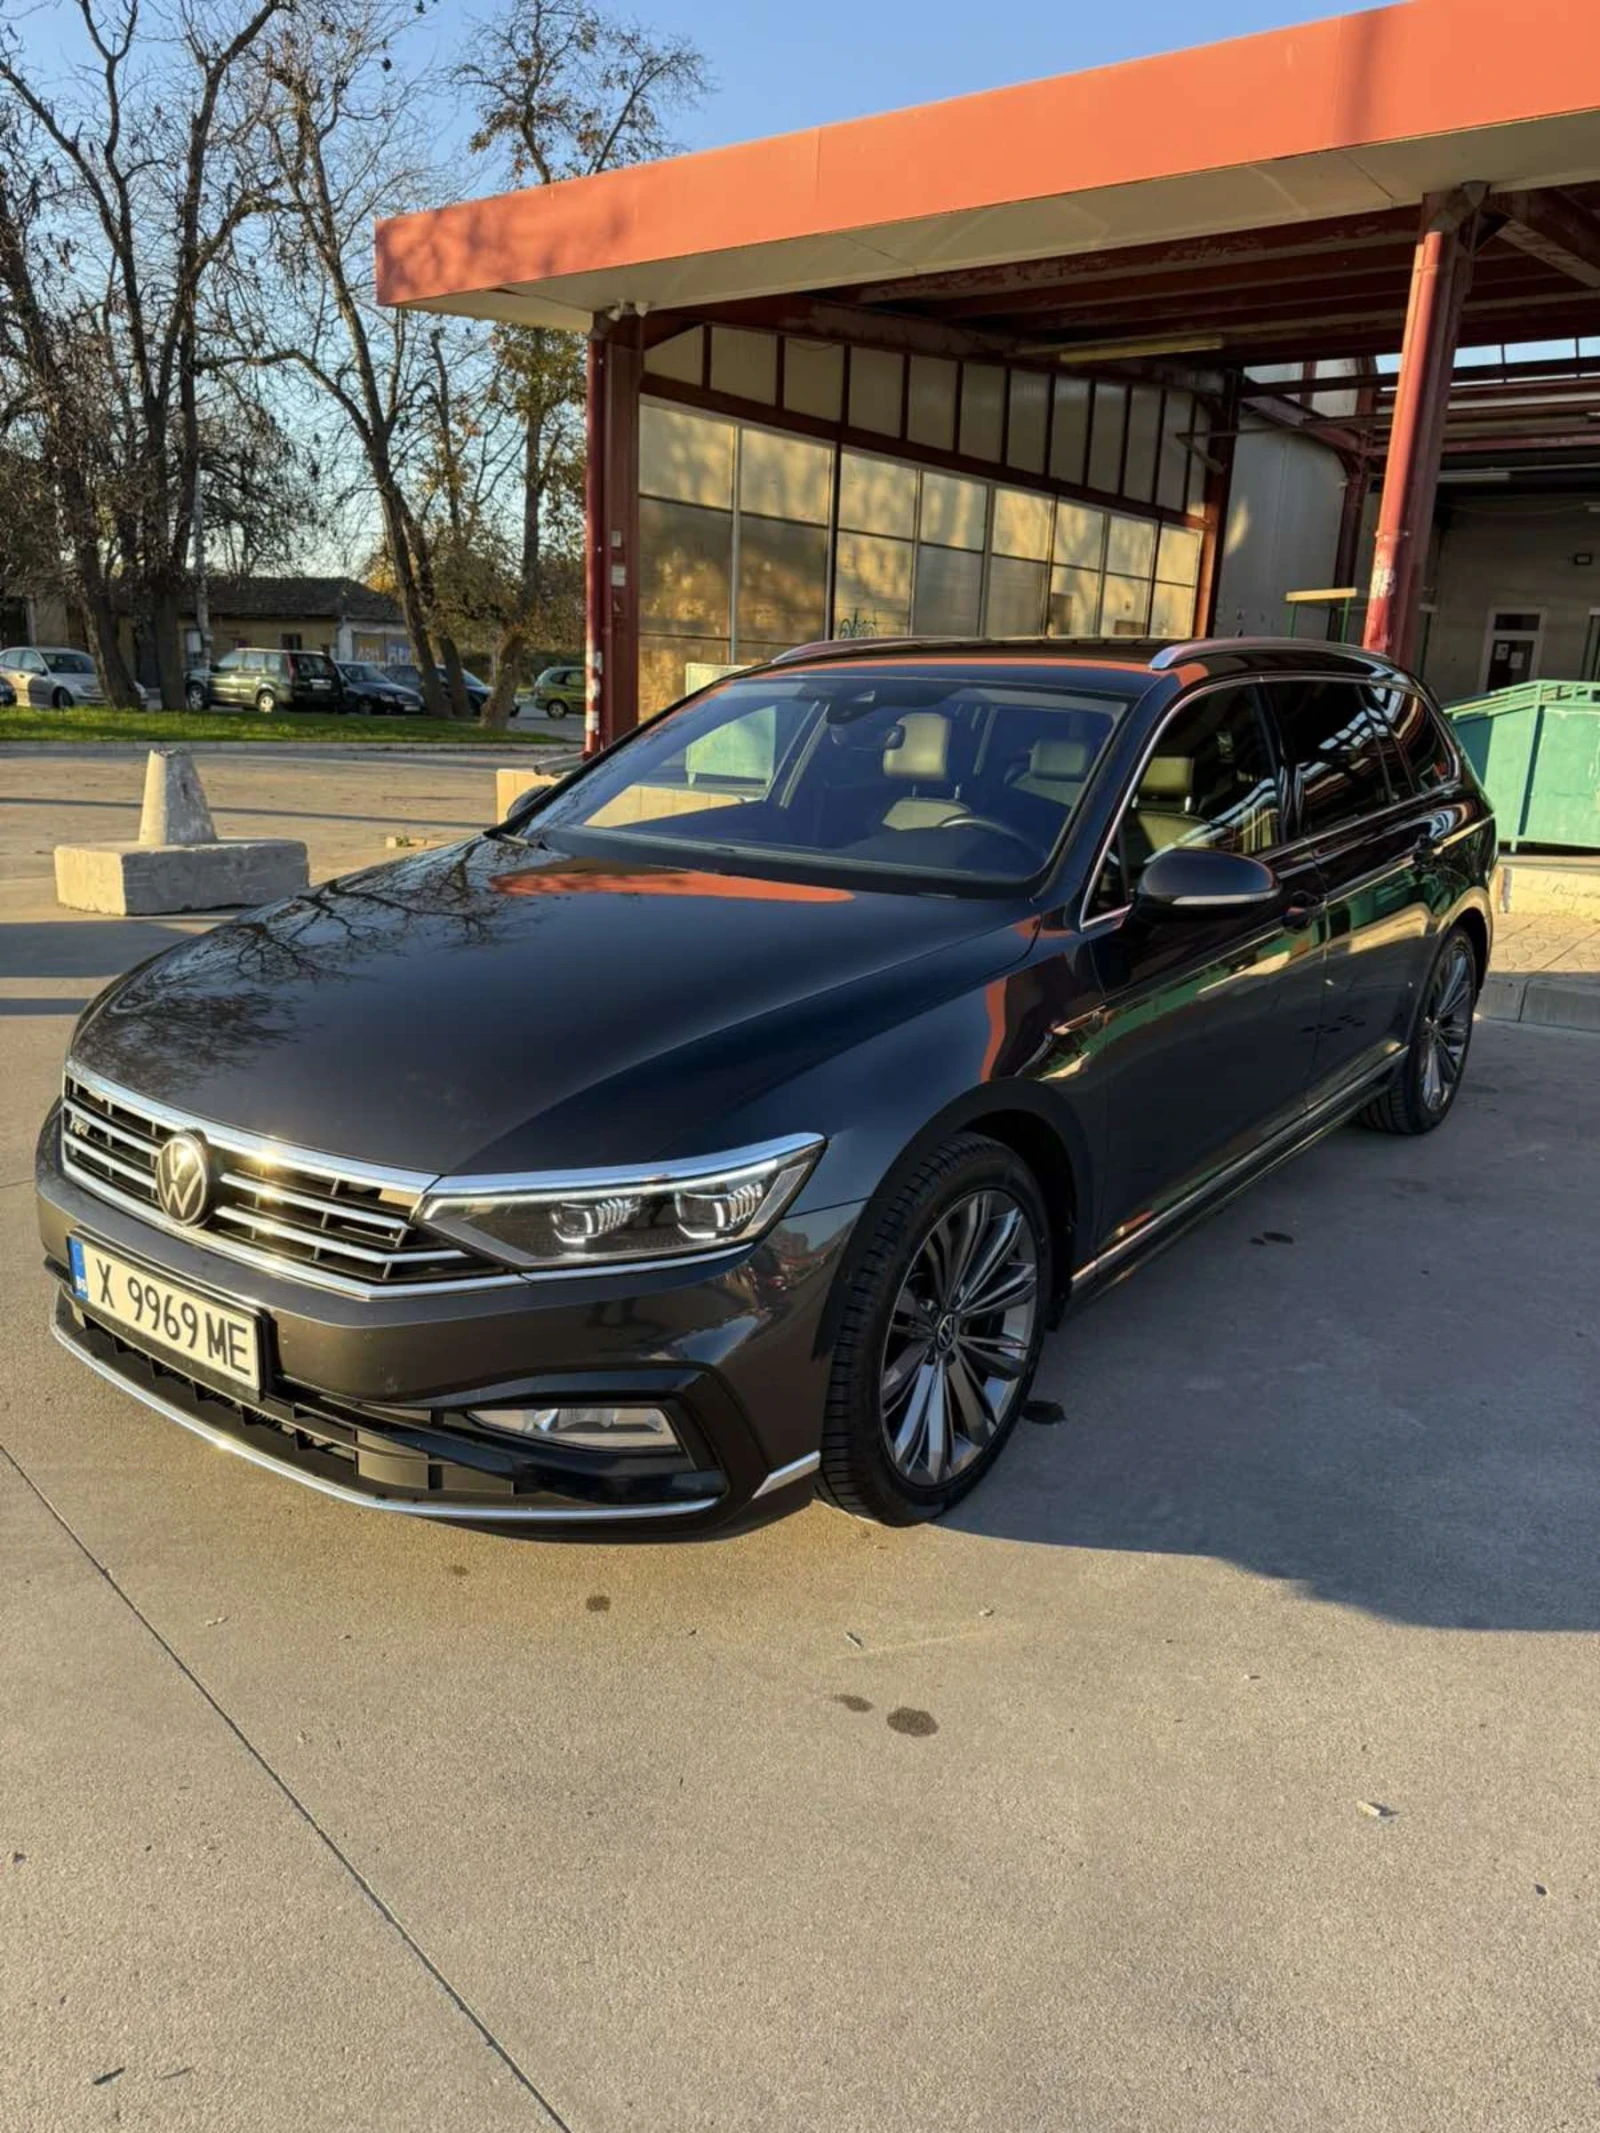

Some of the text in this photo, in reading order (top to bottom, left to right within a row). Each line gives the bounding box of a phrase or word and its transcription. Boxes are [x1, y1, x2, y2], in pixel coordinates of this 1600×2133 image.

[96, 1258, 251, 1377] X 9969 ME
